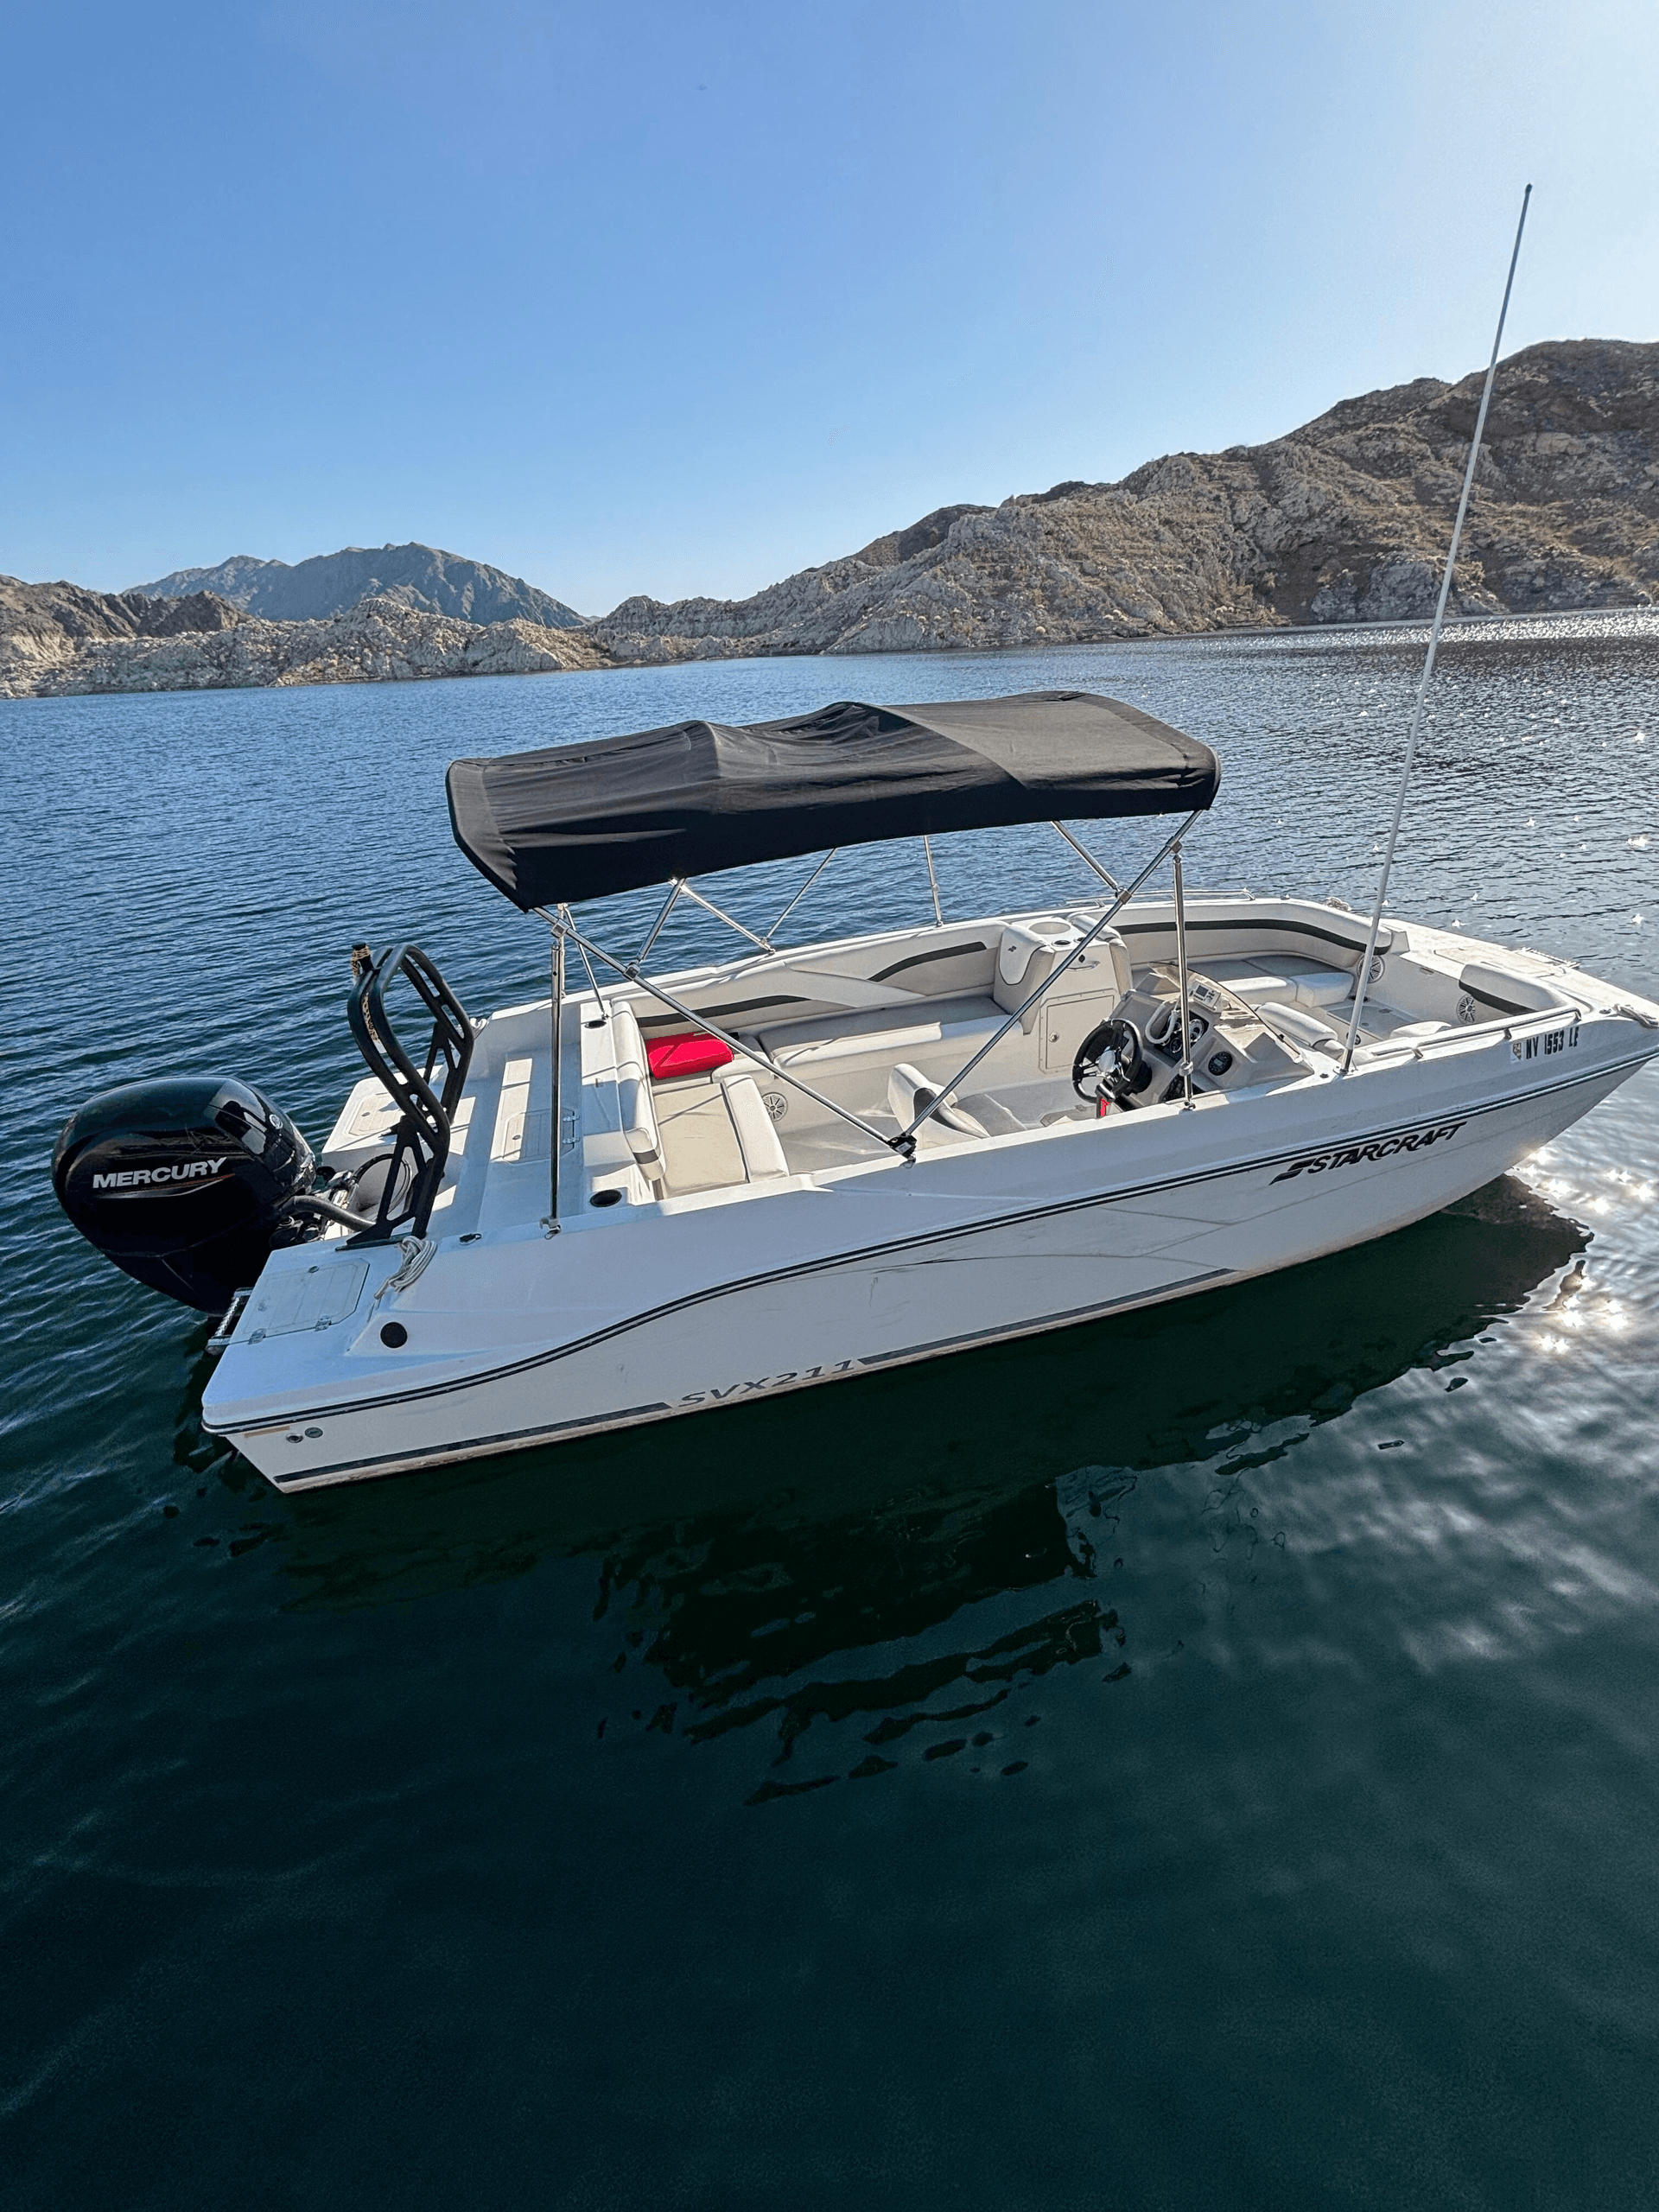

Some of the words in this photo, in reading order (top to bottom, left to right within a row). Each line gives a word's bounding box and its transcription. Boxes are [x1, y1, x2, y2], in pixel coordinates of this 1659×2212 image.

[1526, 1036, 1539, 1059] NV
[1544, 1030, 1564, 1055] 1553
[1306, 1121, 1468, 1175] STARCRAFT
[92, 1156, 227, 1189] MERCURY
[678, 1359, 855, 1408] SVX211
